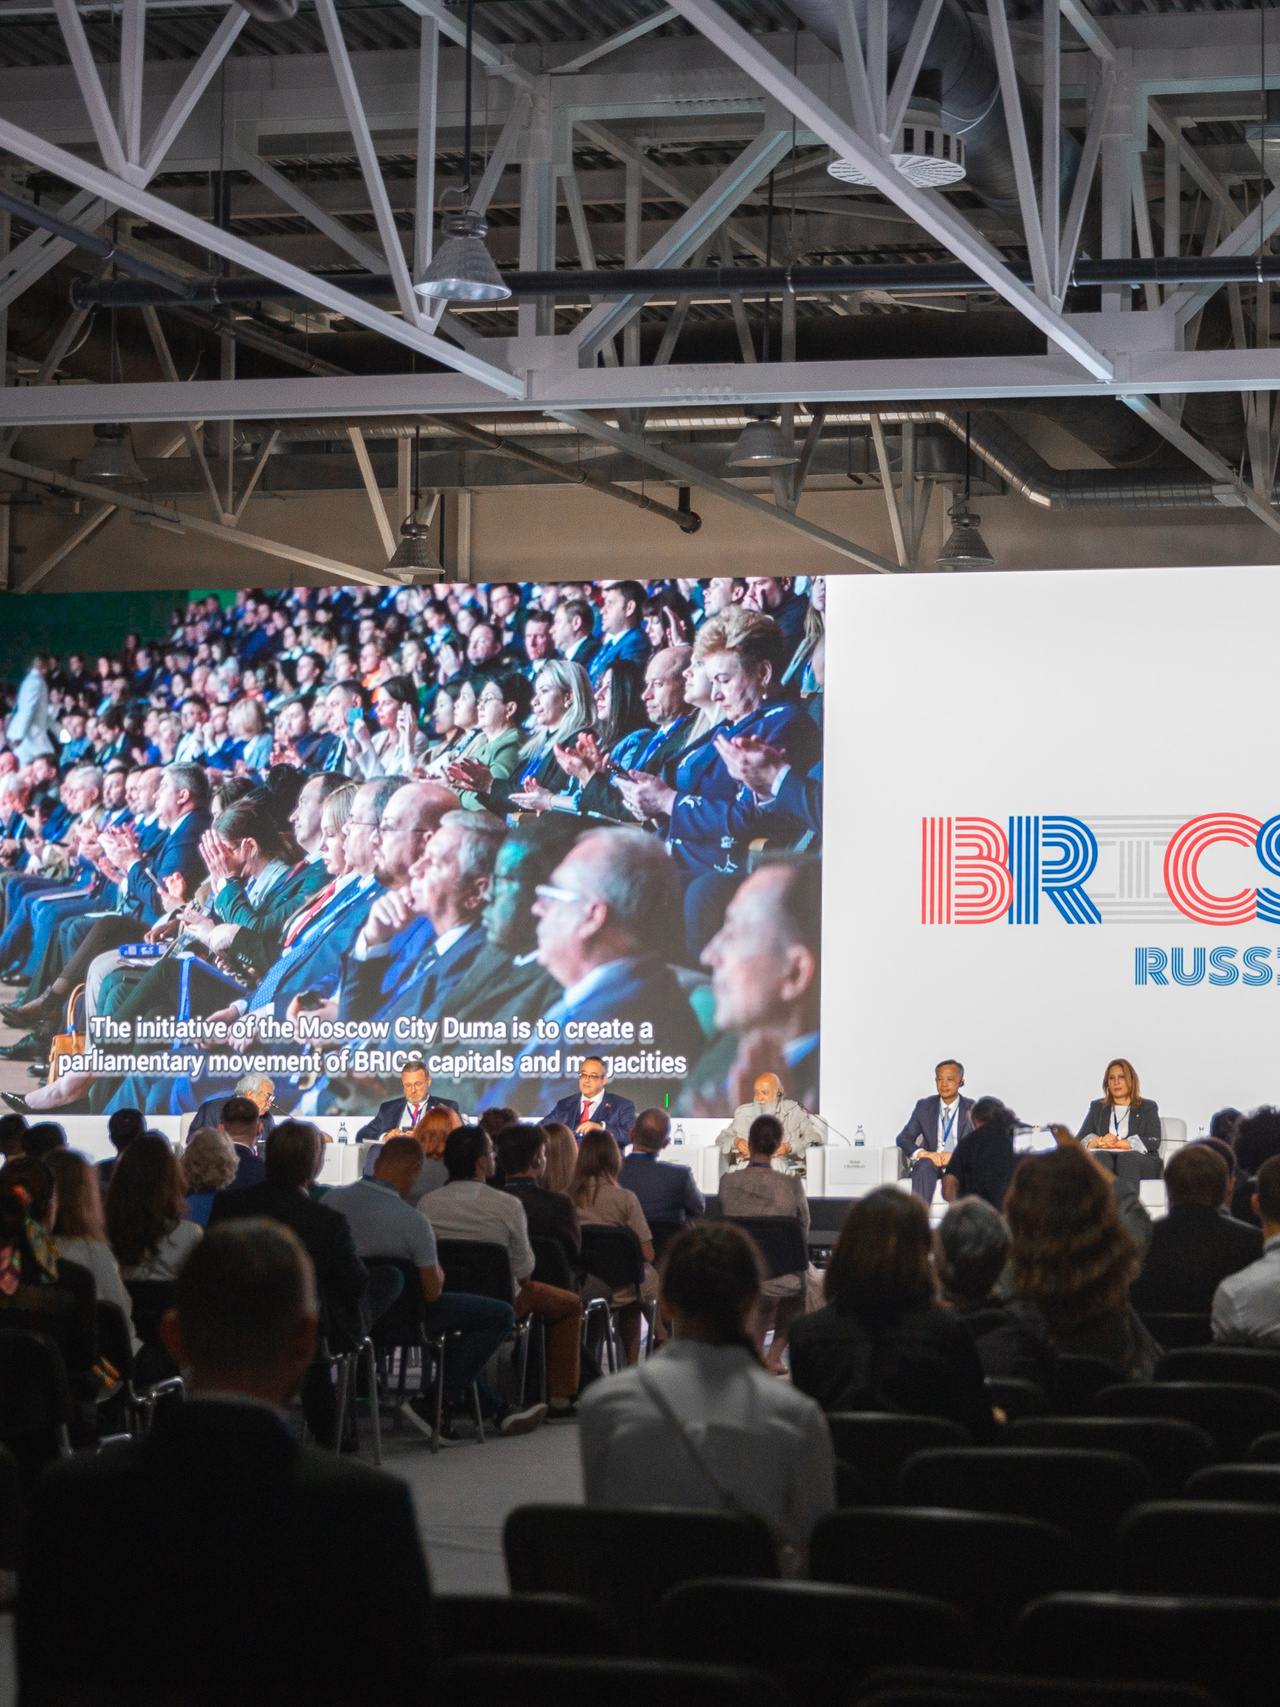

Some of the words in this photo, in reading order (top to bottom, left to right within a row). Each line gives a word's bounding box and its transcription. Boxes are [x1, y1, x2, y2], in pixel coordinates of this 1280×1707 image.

[91, 1017, 131, 1039] The
[136, 1017, 227, 1039] initiative
[232, 1016, 257, 1039] of
[258, 1016, 294, 1039] the
[299, 1017, 390, 1040] Moscow
[394, 1017, 438, 1045] City
[443, 1017, 507, 1039] Duma
[512, 1017, 531, 1039] is
[536, 1018, 560, 1039] to
[564, 1018, 634, 1039] create
[639, 1021, 653, 1039] a
[58, 1048, 204, 1078] parliamentary
[208, 1052, 318, 1073] movement
[325, 1049, 350, 1073] of
[428, 1049, 514, 1079] capitals
[519, 1049, 561, 1074] and
[566, 1050, 687, 1078] mgacities
